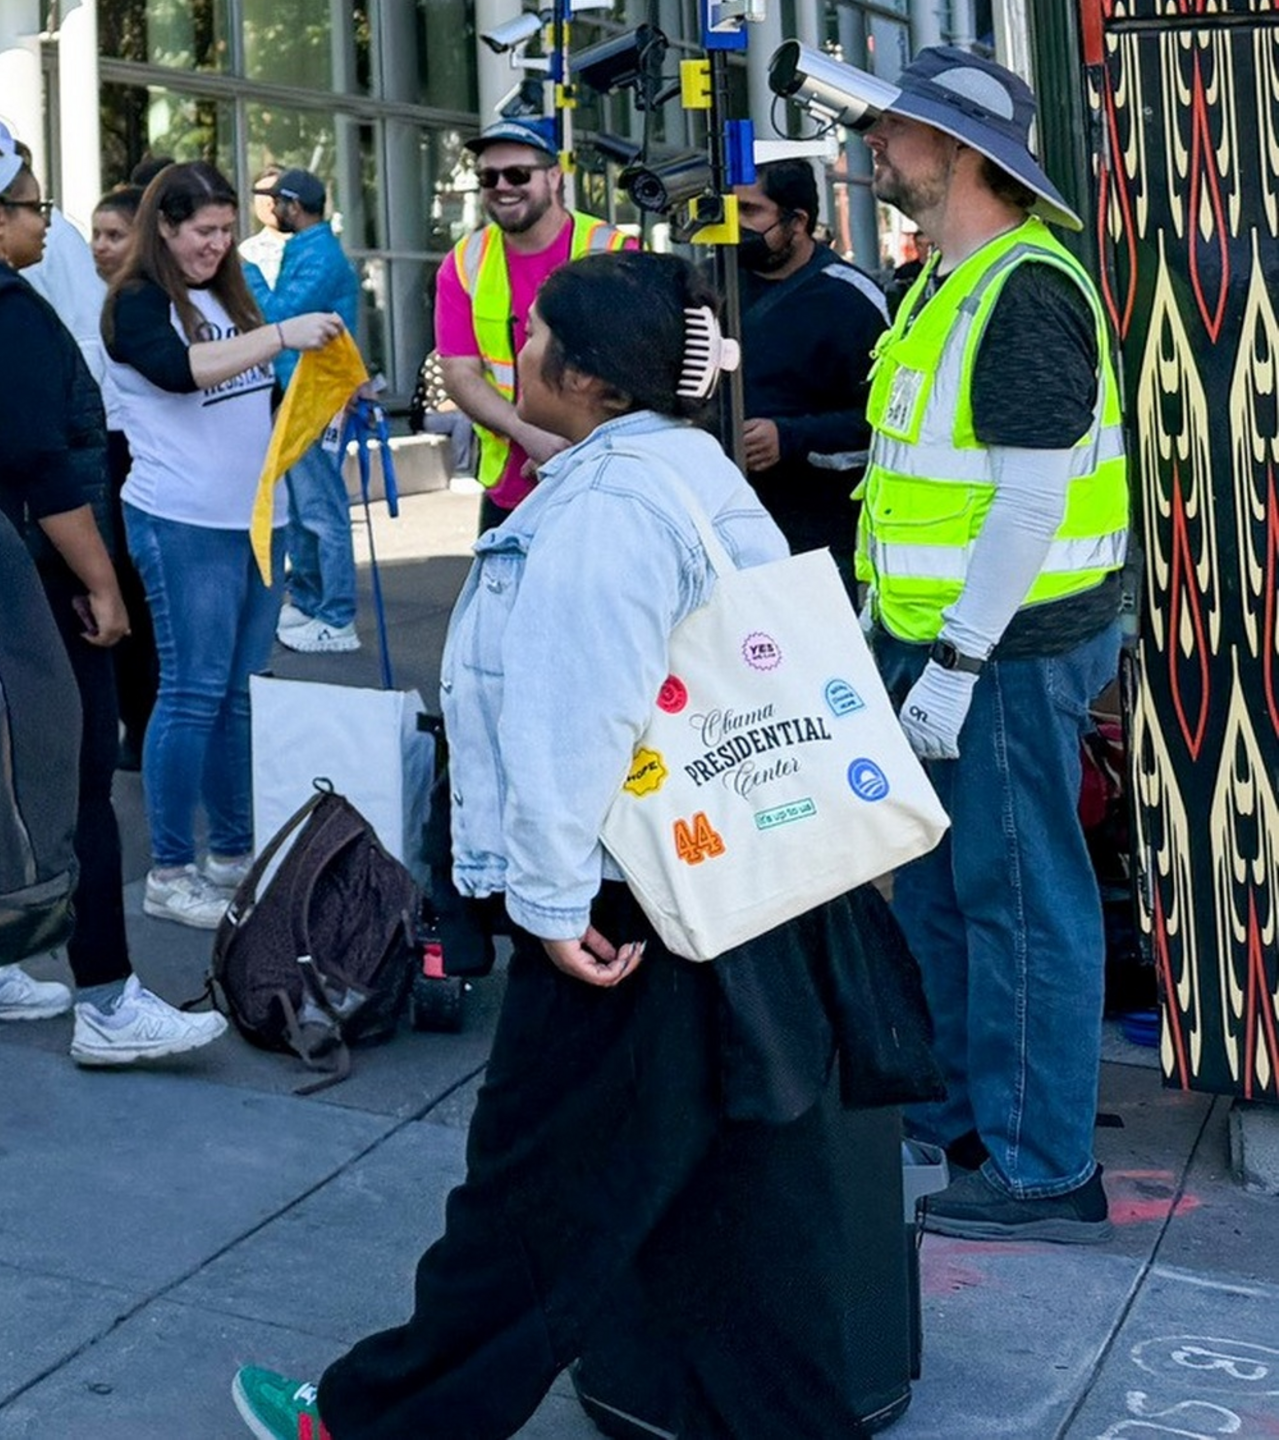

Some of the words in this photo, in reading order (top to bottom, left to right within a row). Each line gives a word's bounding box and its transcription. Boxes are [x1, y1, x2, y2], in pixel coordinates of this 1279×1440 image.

[749, 643, 774, 655] YES
[684, 717, 832, 787] PRESIDENTIAL
[722, 760, 801, 802] Center
[673, 810, 725, 865] 44
